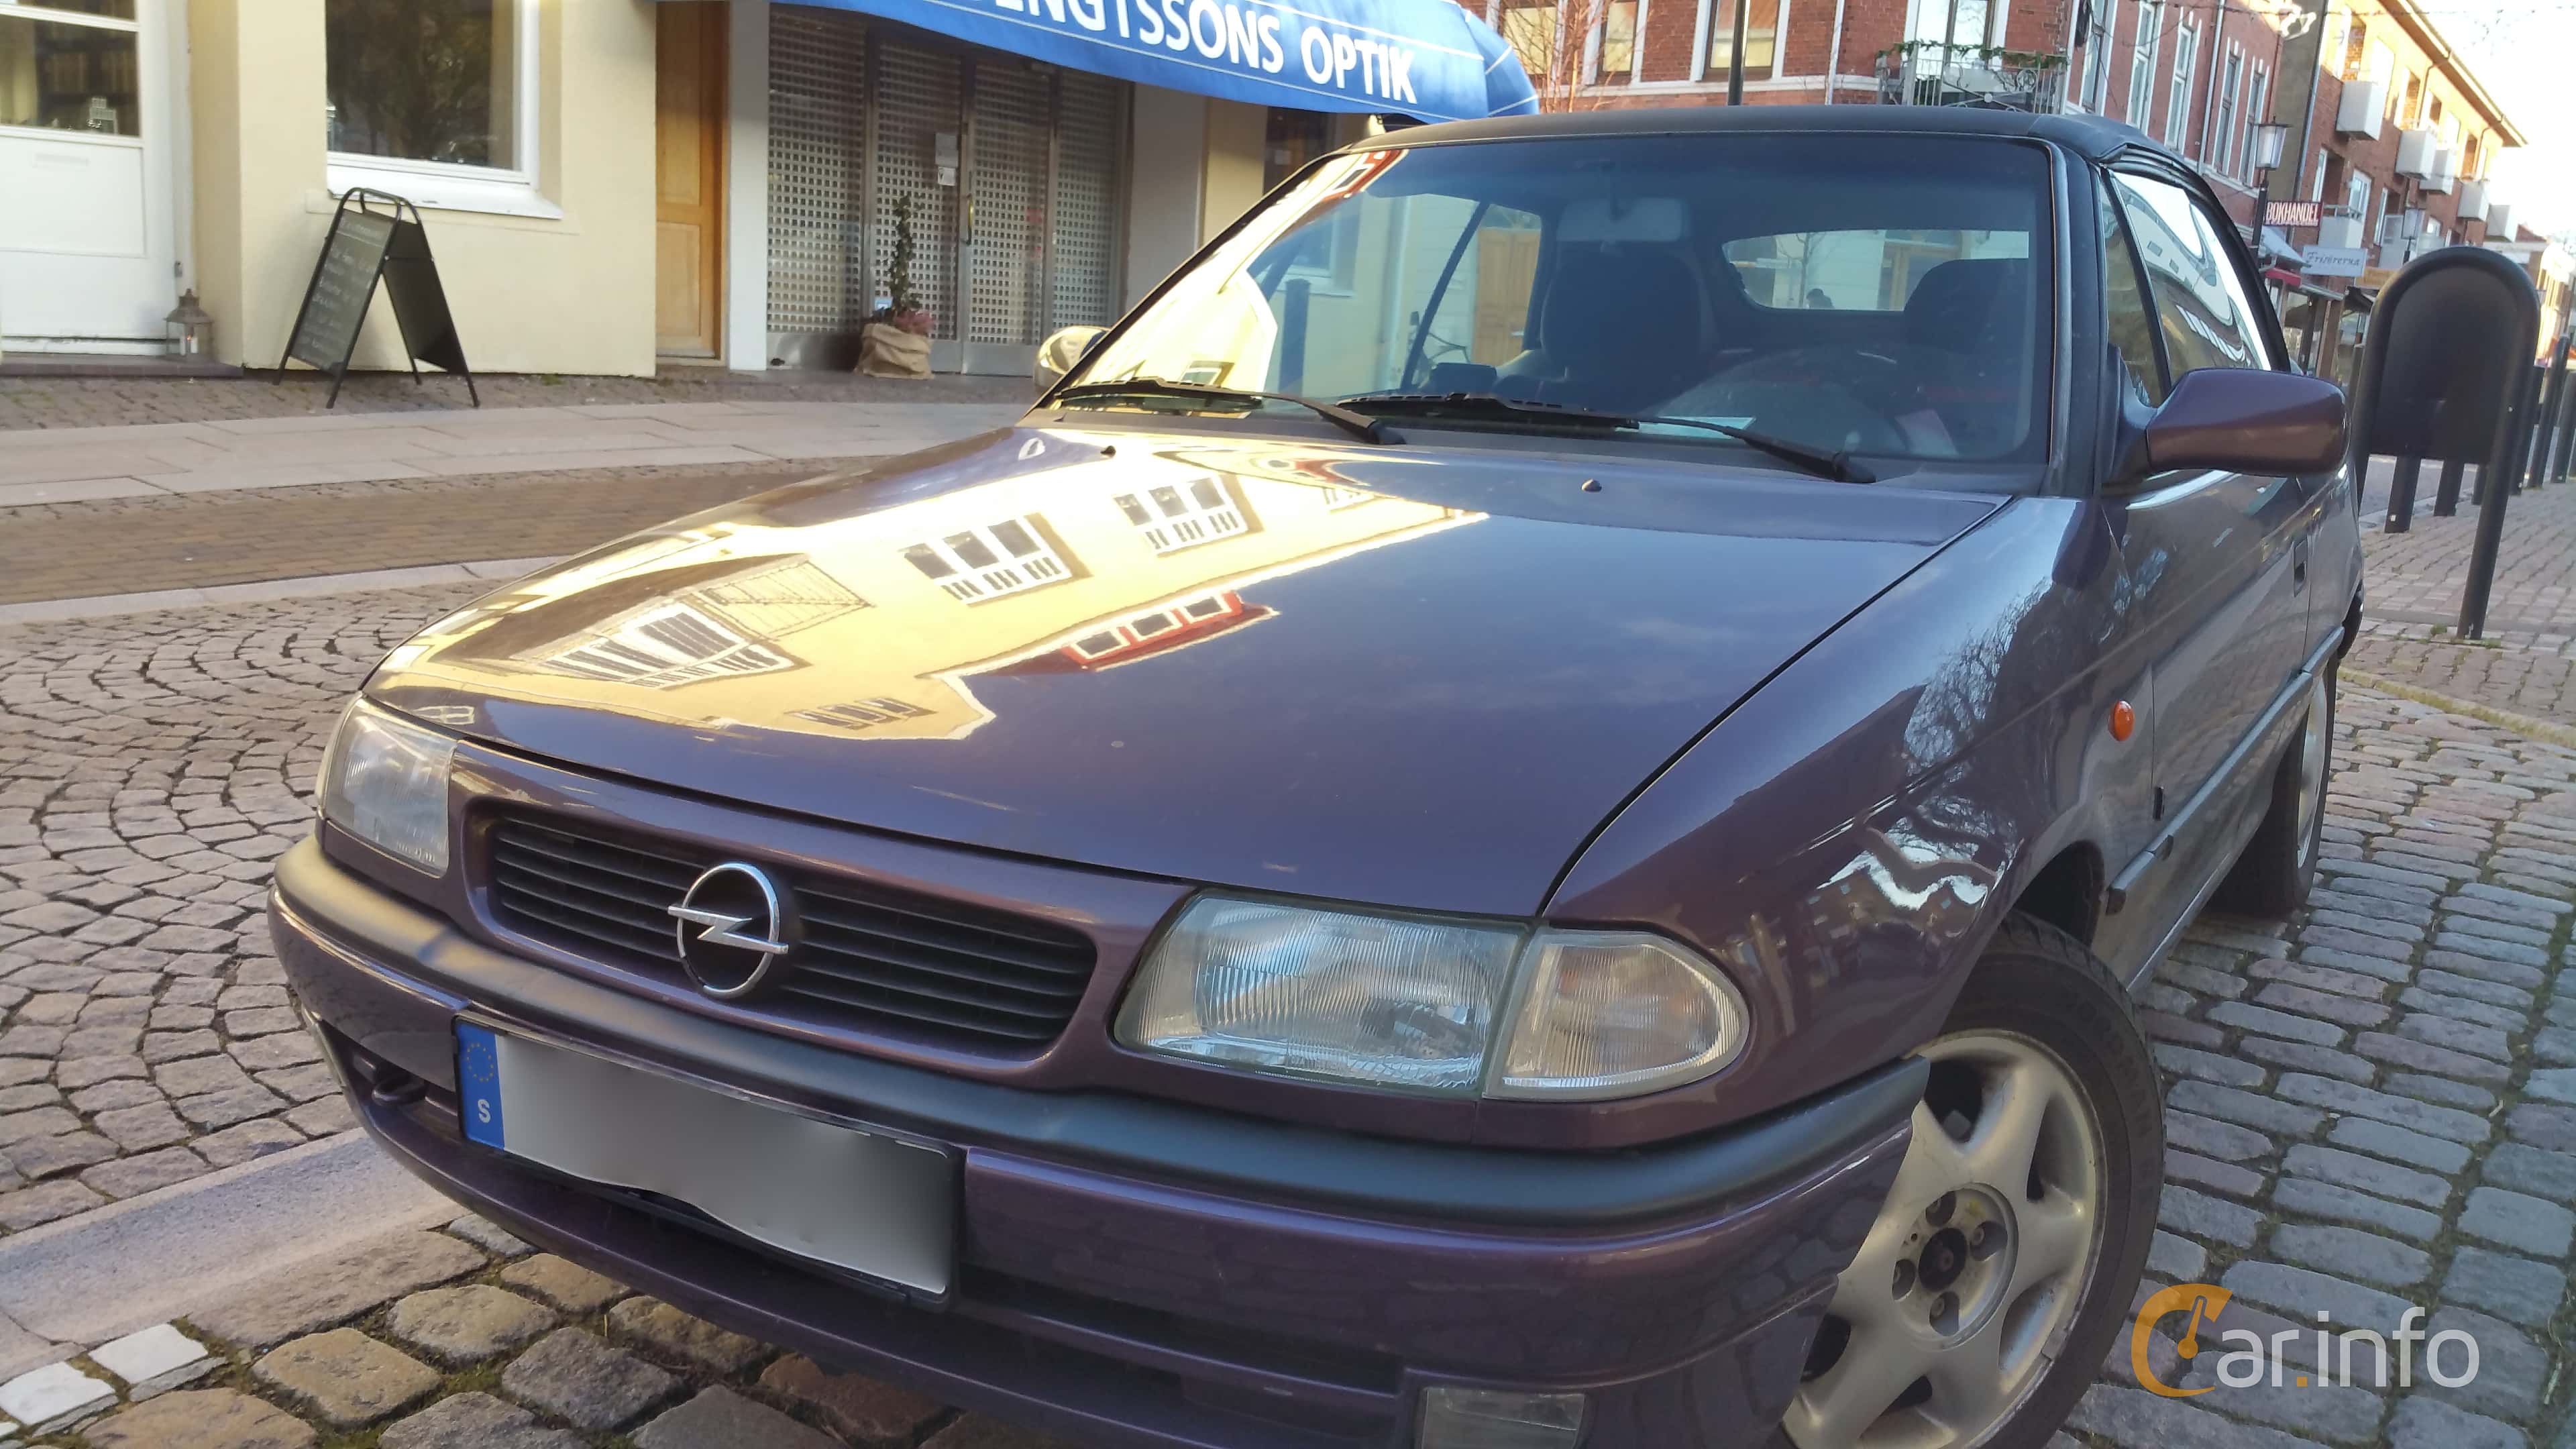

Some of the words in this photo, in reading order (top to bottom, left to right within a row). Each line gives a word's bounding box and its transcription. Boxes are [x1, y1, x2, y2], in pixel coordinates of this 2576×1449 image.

[973, 0, 1284, 73] GTSSONS
[1300, 25, 1417, 104] OPTIK
[2265, 201, 2319, 224] BOKHANDEL
[478, 1098, 491, 1124] S
